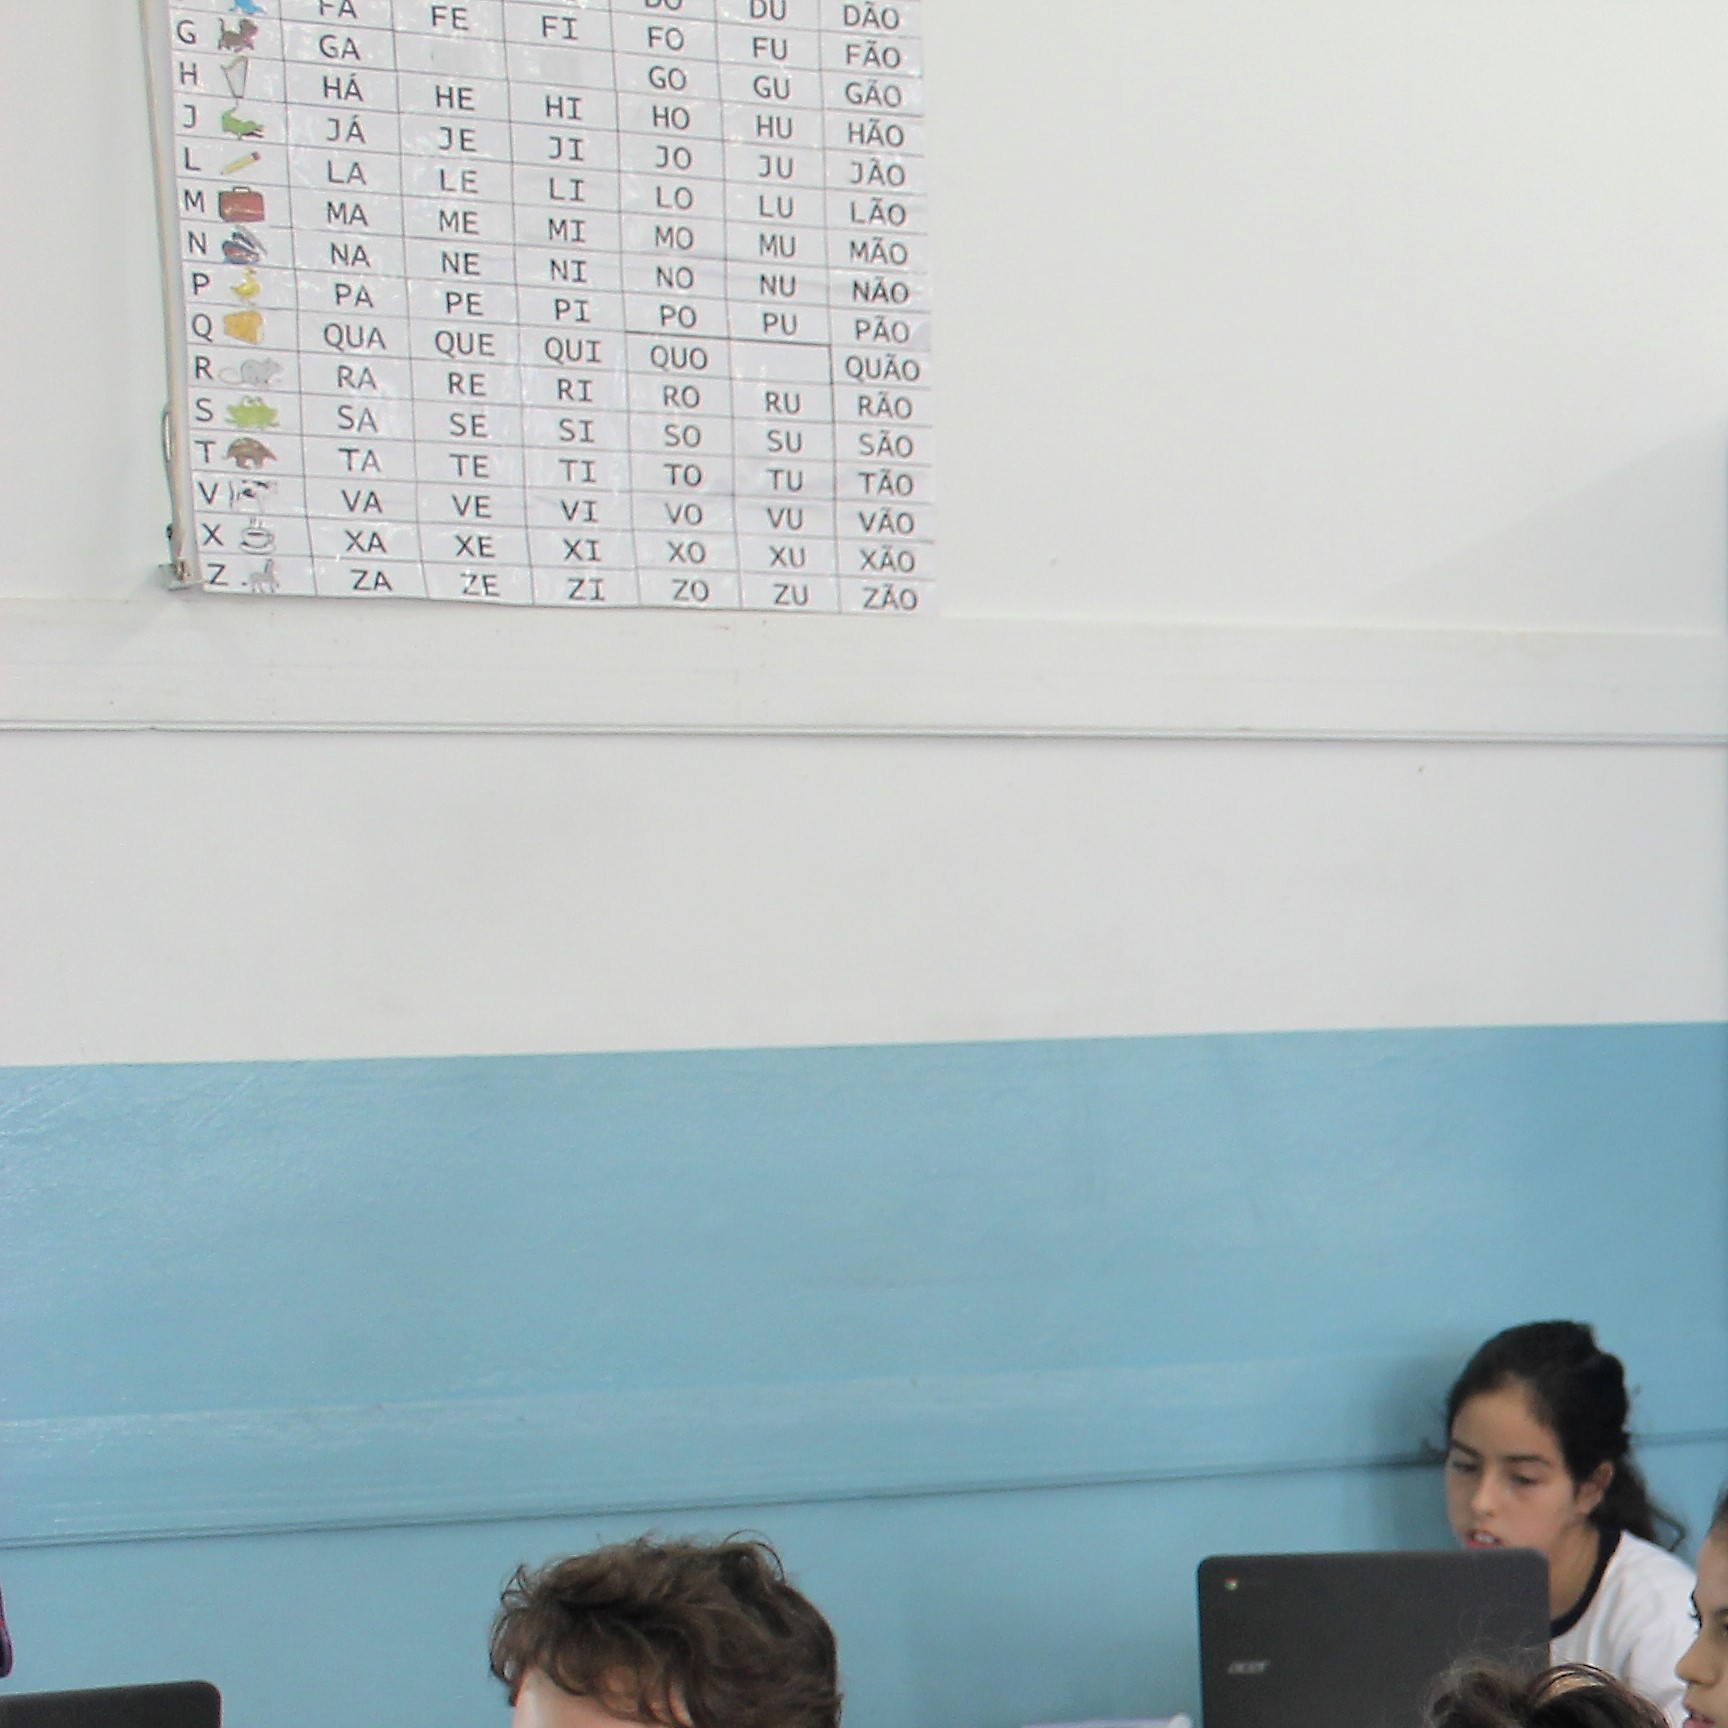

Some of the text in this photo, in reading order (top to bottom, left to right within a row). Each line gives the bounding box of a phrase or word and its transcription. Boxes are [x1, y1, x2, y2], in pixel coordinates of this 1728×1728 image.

[431, 5, 469, 31] FE
[541, 15, 578, 41] FI
[647, 26, 684, 51] FO
[753, 36, 787, 61] FU
[846, 41, 901, 69] FÃO
[749, 0, 899, 30] DU DÃO
[177, 20, 902, 109] G GA GO GU GÃO
[180, 62, 904, 147] H HÁ HE HI HO HU HÃO
[183, 105, 905, 186] J JÁ JE JI JO JU JÃO
[184, 147, 906, 226] L LA LE LI LO LU LÃO
[184, 189, 908, 265] M MA ME MI MO MU MÃO
[188, 231, 910, 303] N NA NE NI NO NU NÃO
[192, 272, 909, 343] P PA PE PI PO PU PÃO
[192, 314, 920, 384] Q QUA QUE QUI QUO QUÃO
[195, 356, 912, 419] R RA RE RI RO RU RÃO
[196, 398, 913, 458] S SA SE SI SO SU SÃO
[195, 440, 913, 496] T TA TE TI TO TU TÃO
[198, 482, 914, 534] V VA VE VI VO VU VÃO
[202, 523, 915, 573] X XA XE XI XO XU XÃO
[208, 563, 918, 610] Z ZA ZE ZI ZO ZU ZÃO
